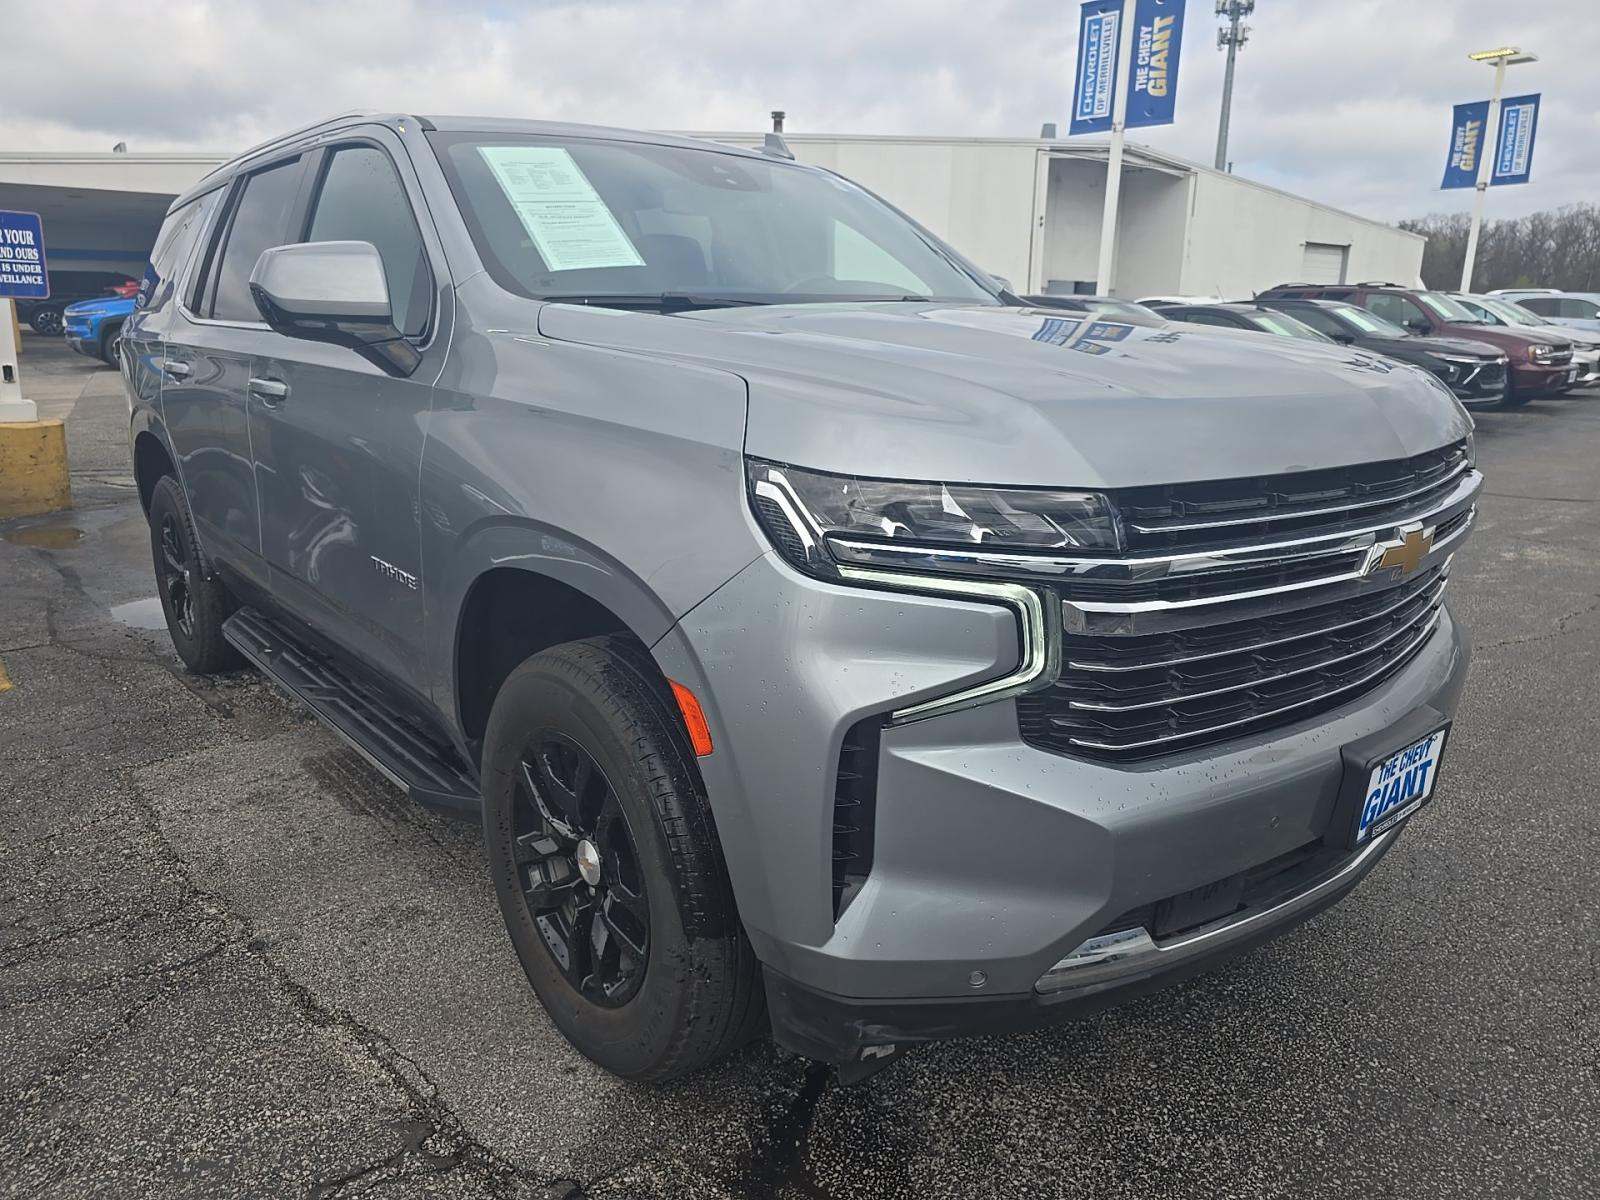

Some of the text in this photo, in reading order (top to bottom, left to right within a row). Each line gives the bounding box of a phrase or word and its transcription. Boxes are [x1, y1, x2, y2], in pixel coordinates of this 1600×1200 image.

[1083, 23, 1100, 113] CHEVROLET
[1135, 25, 1152, 92] THE CHEVY
[1147, 14, 1176, 97] GIANT
[1096, 99, 1105, 111] OF
[1459, 120, 1480, 172] GIANT
[1502, 110, 1517, 172] CHEVROLET
[4, 229, 35, 245] YOUR
[15, 247, 39, 260] OURS
[2, 263, 42, 274] IS UNDER
[370, 555, 417, 590] TAHOE
[1378, 735, 1435, 785] THE CHEVY
[1359, 758, 1434, 831] GIANT
